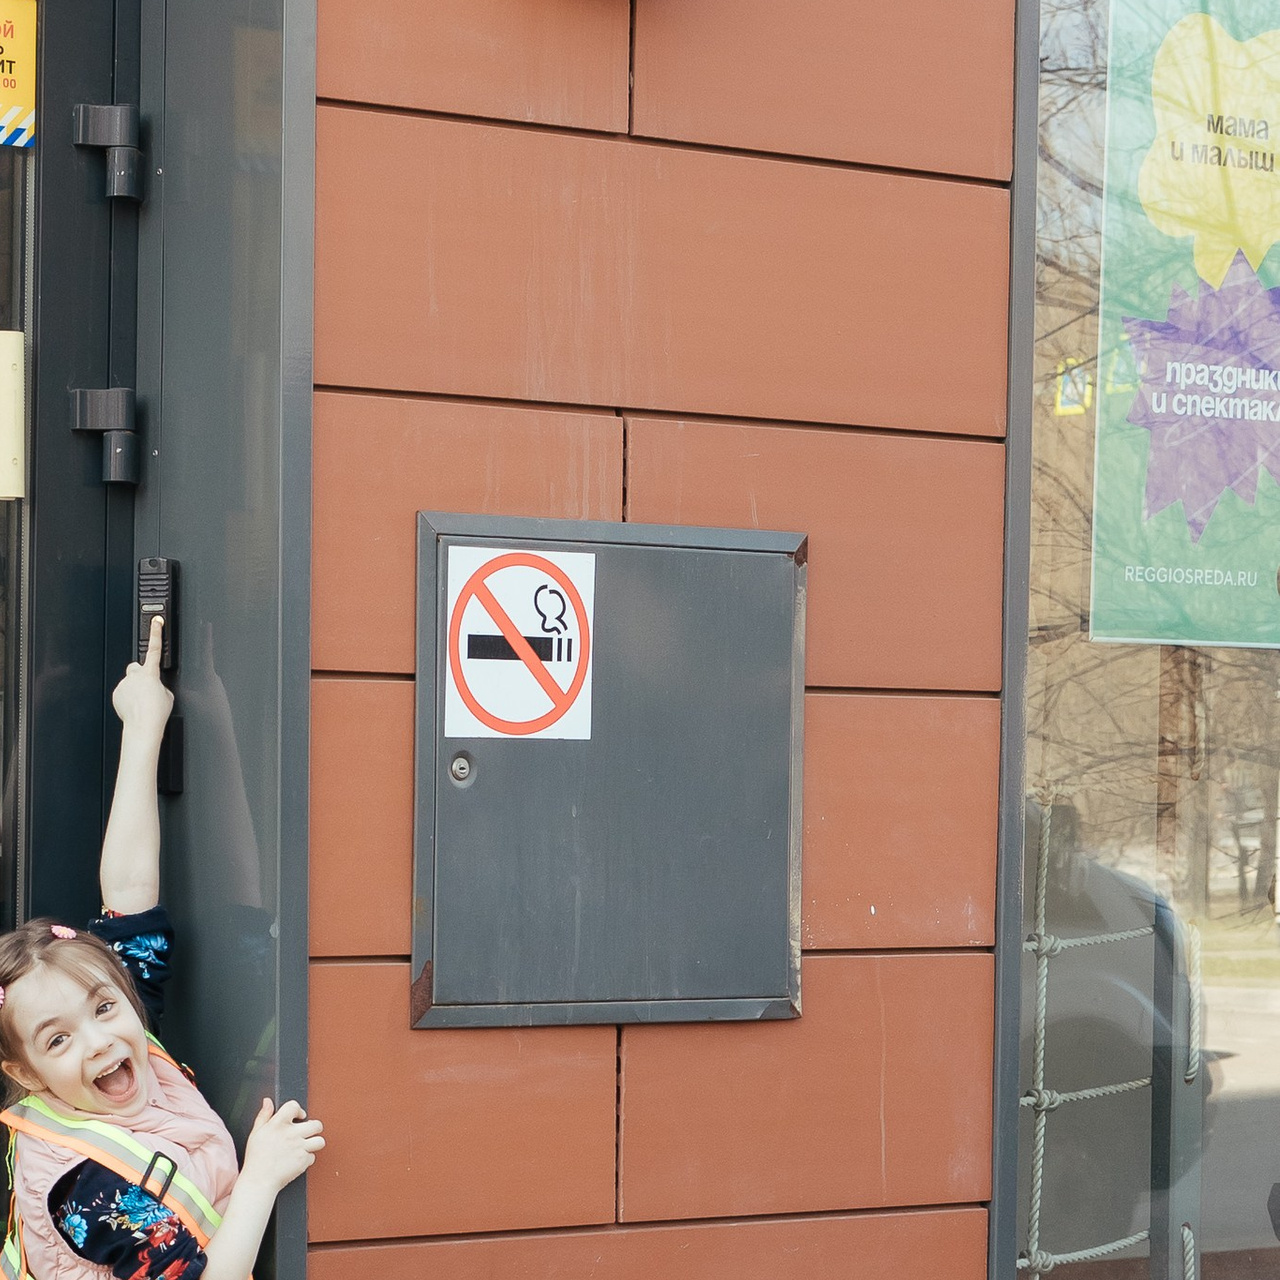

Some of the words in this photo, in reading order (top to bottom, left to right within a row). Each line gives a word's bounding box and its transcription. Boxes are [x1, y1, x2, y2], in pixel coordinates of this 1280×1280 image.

[2, 77, 17, 89] 00
[1207, 114, 1269, 140] мама
[1171, 141, 1184, 161] и
[1191, 143, 1274, 172] малыш
[1152, 392, 1167, 413] и
[1124, 565, 1258, 587] REGGIOSREDA.RU
